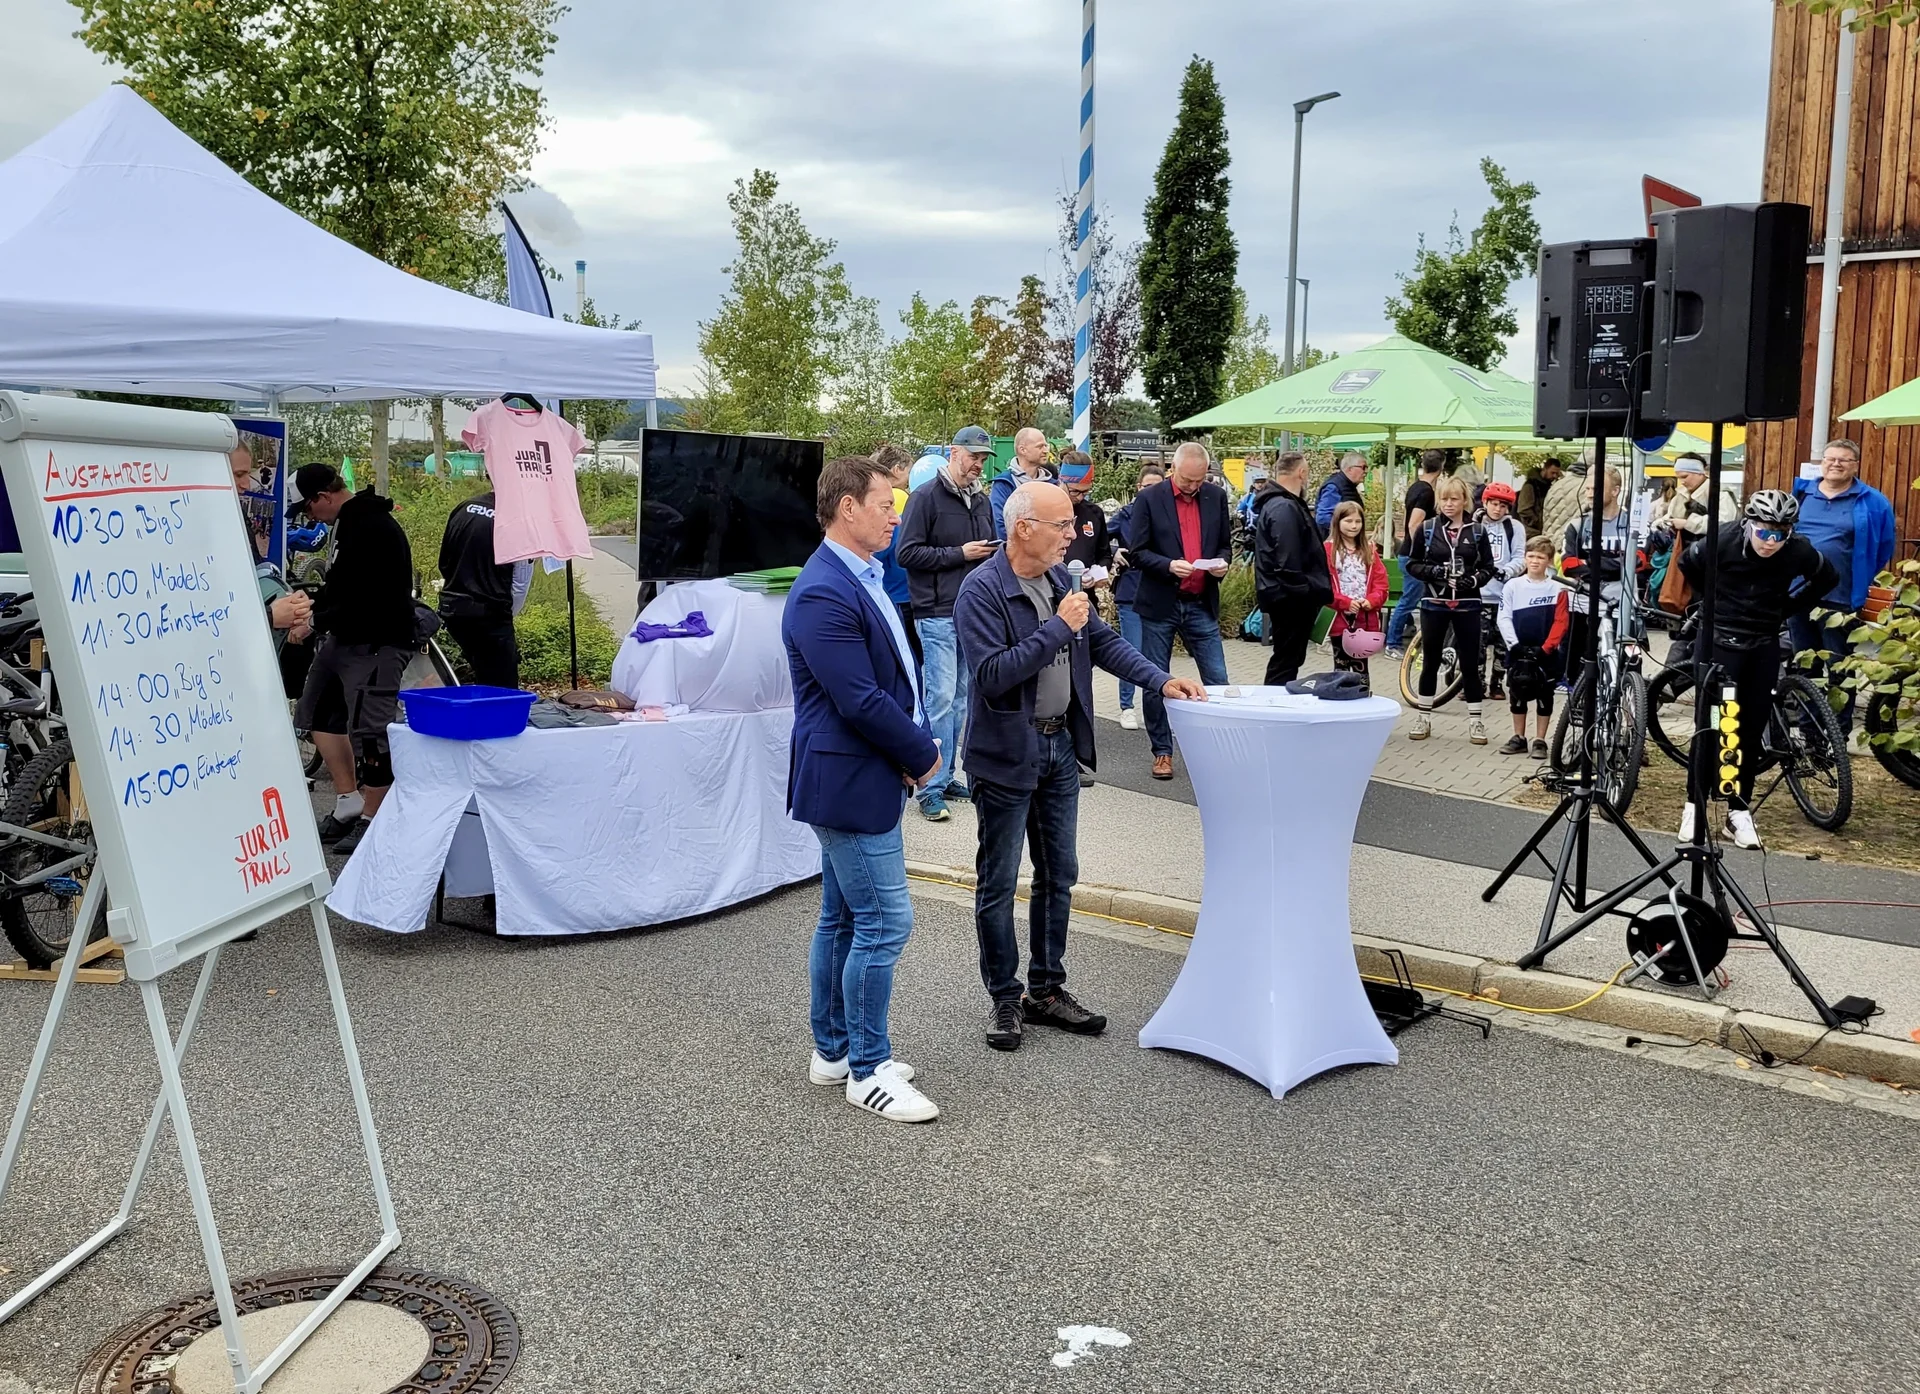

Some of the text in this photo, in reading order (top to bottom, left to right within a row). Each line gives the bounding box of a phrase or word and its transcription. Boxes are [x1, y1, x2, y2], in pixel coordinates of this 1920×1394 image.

[1274, 404, 1384, 415] Lammsbräu
[1297, 397, 1377, 406] Neumarkter
[52, 504, 124, 548] 10:30
[71, 568, 138, 605] 11:00
[1528, 595, 1556, 606] LEATT
[81, 611, 151, 655] 11:30
[123, 763, 190, 809] 15:00
[237, 851, 291, 894] TRAILS
